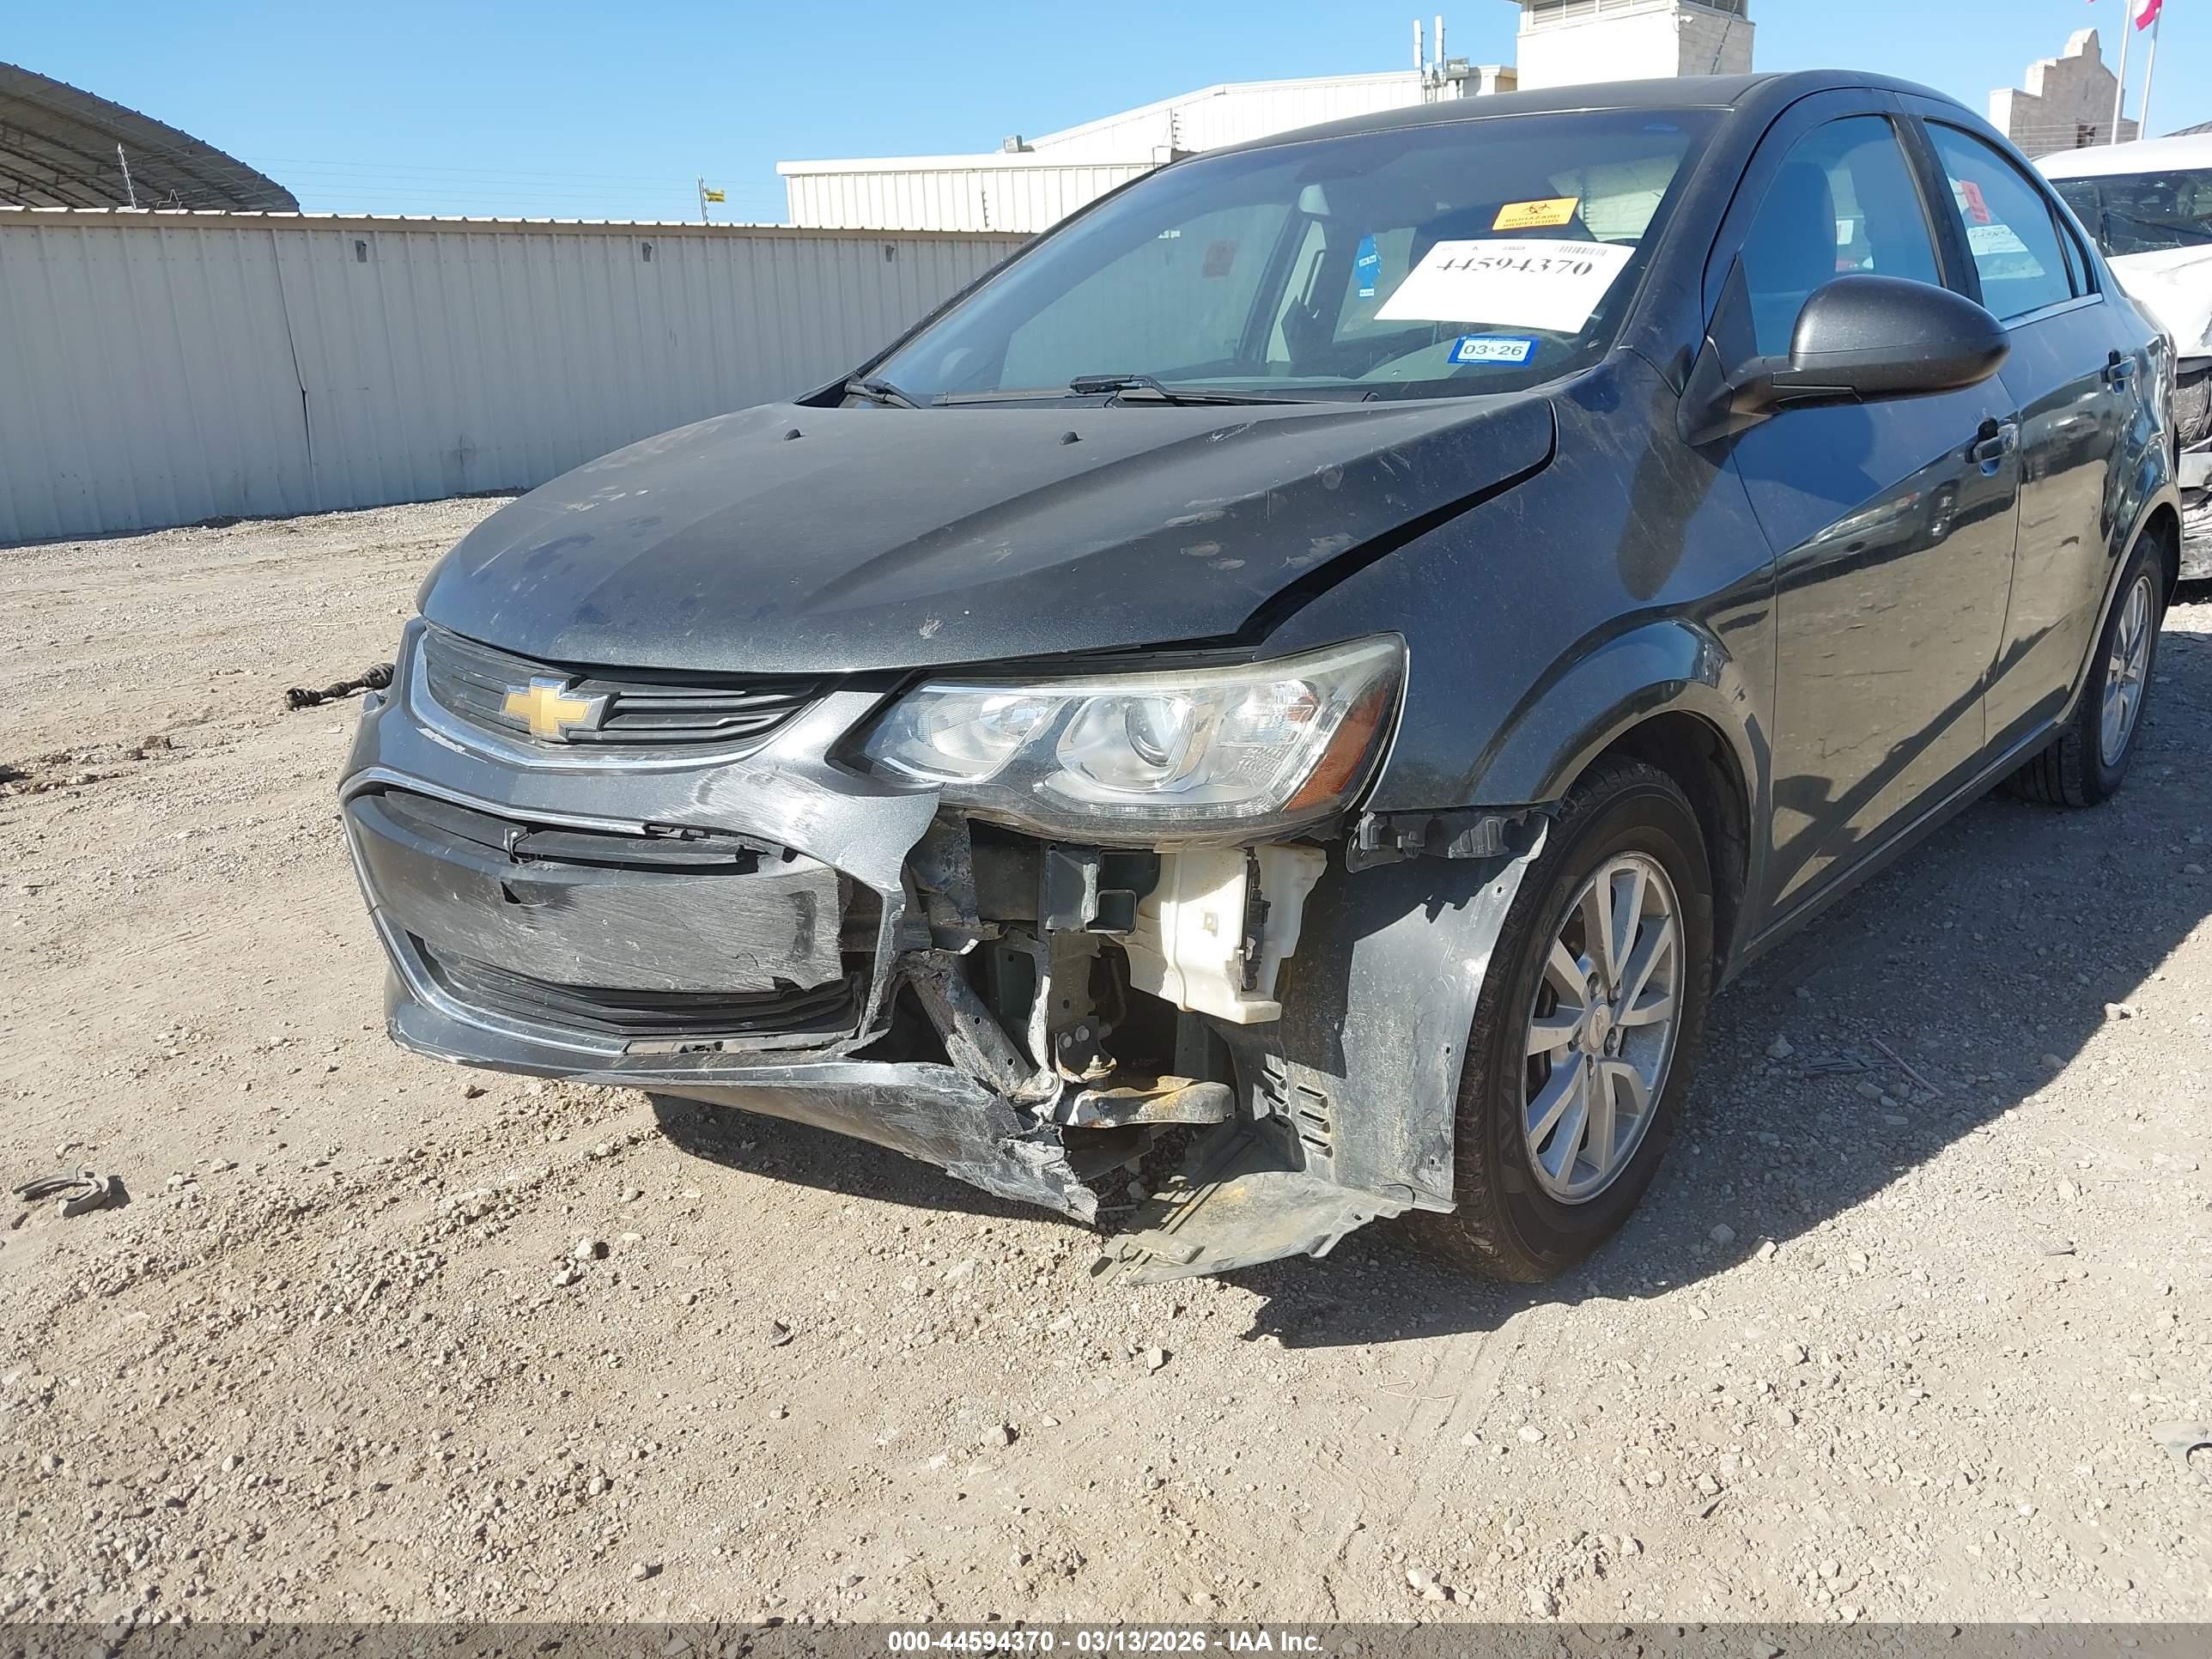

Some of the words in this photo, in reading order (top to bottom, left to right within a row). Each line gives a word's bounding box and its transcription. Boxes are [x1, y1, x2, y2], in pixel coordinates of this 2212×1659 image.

[1437, 258, 1593, 276] 44594370
[1463, 344, 1488, 355] 03
[1497, 345, 1524, 356] 26
